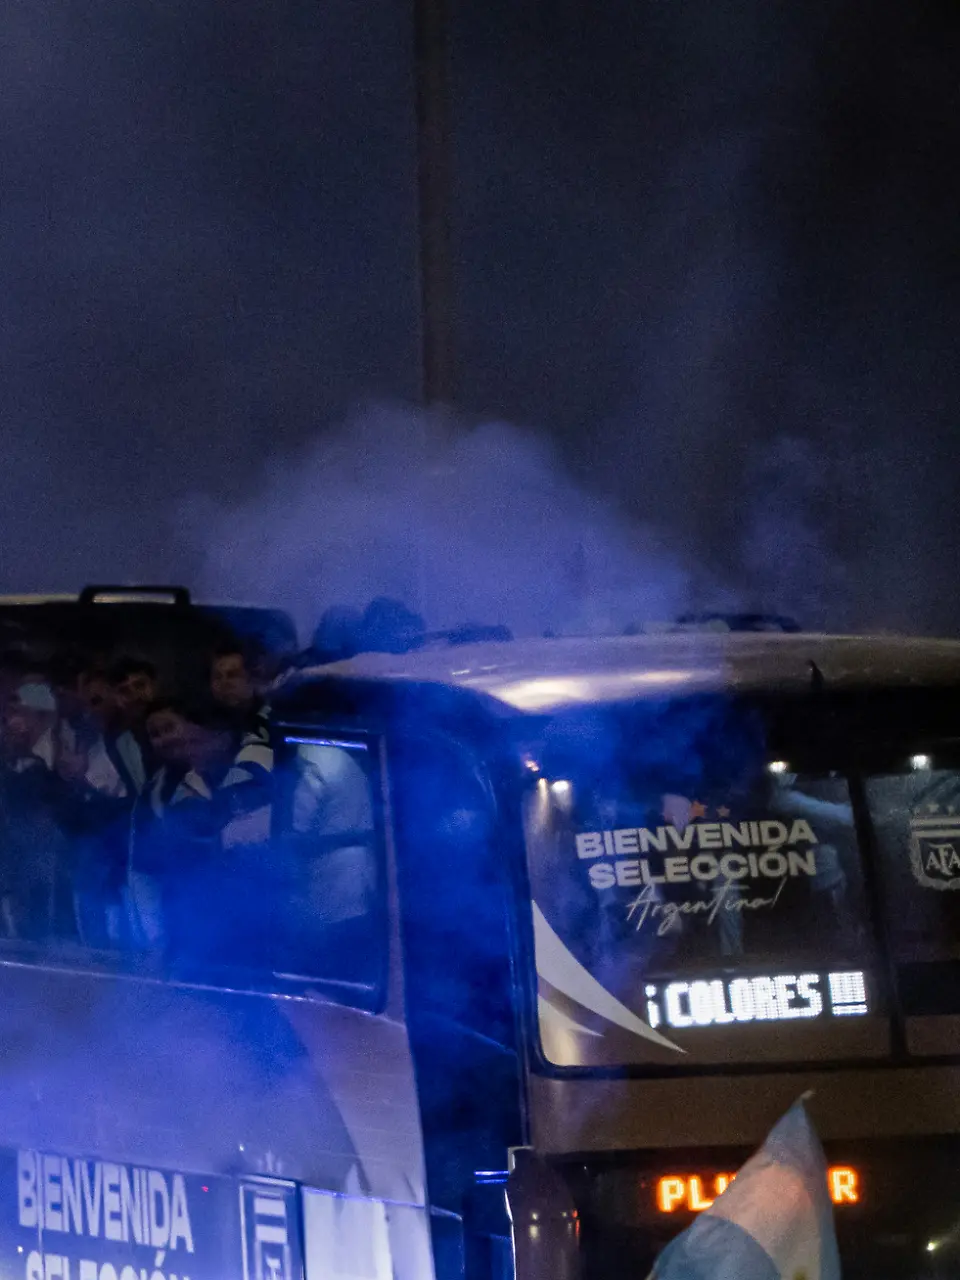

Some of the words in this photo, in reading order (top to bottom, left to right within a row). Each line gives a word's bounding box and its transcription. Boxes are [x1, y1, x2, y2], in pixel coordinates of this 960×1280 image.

[575, 819, 818, 860] BIENVENIDA
[589, 844, 817, 889] SELECCIÓN
[17, 1148, 194, 1254] BIENVENIDA
